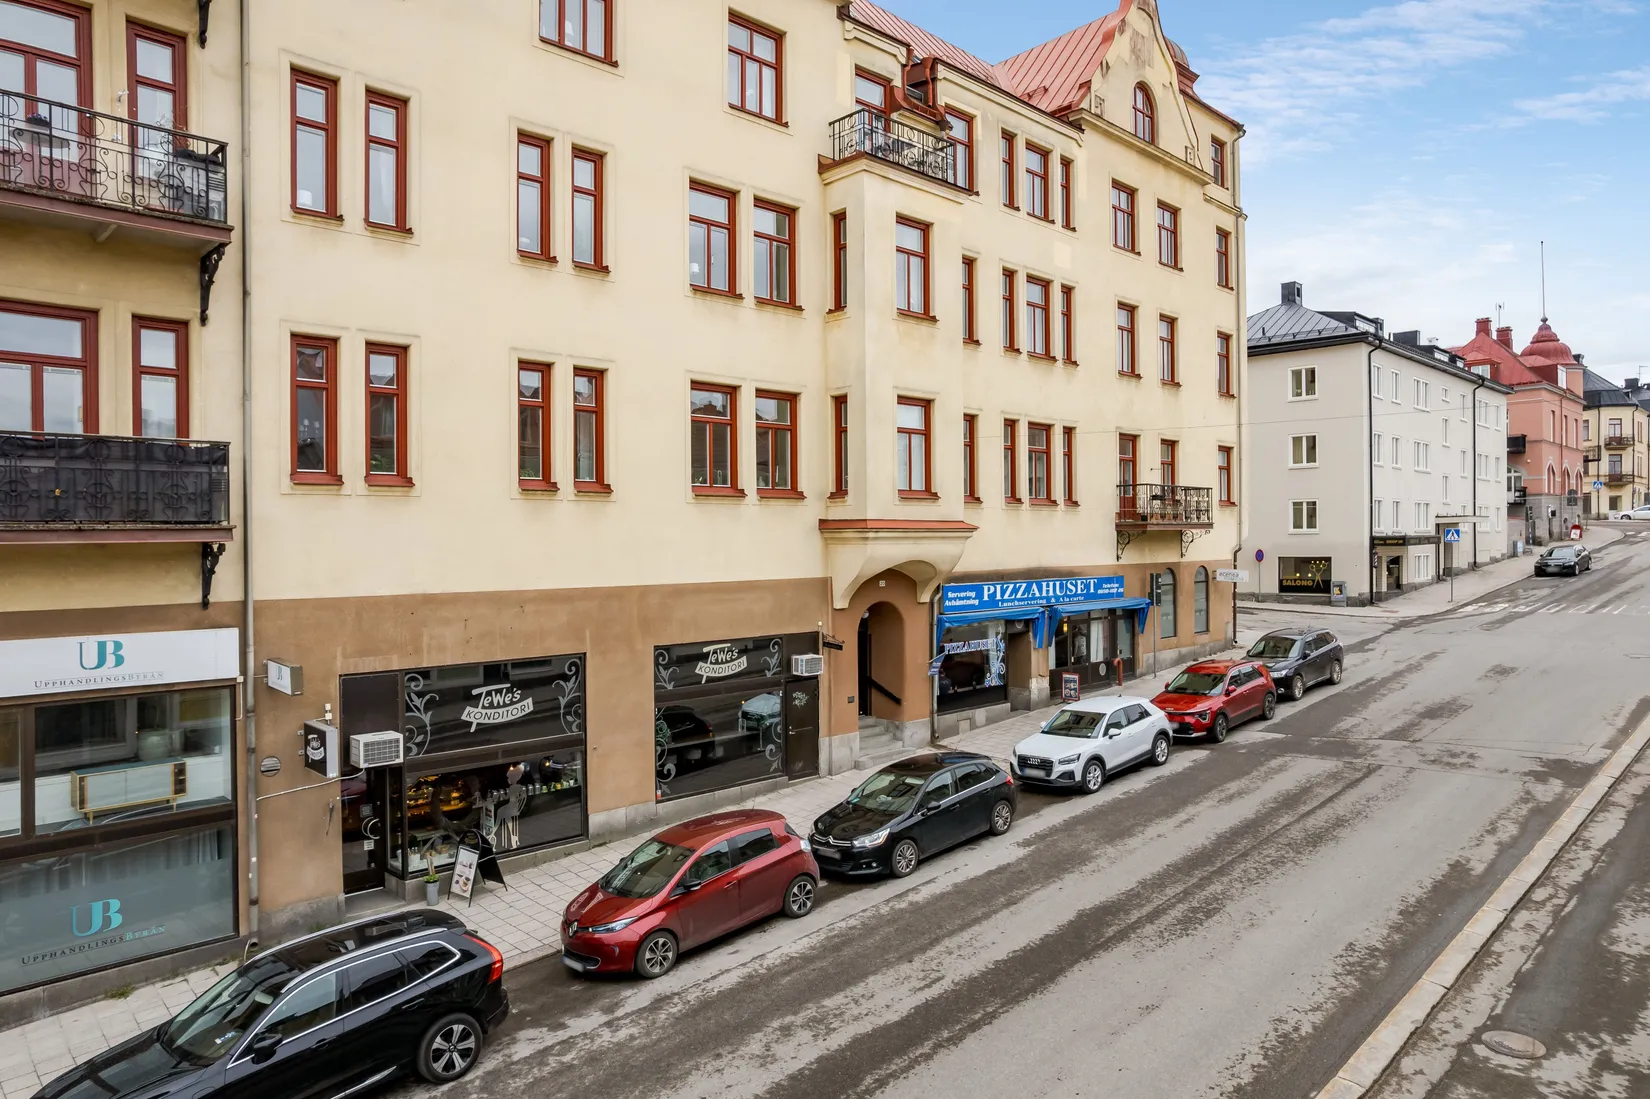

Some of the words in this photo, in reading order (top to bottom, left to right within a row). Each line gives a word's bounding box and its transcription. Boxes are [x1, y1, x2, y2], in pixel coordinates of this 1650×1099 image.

[947, 591, 976, 599] Servering
[983, 579, 1098, 601] PIZZAHUSET
[998, 598, 1047, 608] Lunchservering
[77, 640, 125, 670] UB
[697, 659, 745, 675] KONDITORI
[465, 702, 530, 721] KONDITORI
[71, 898, 123, 937] UB
